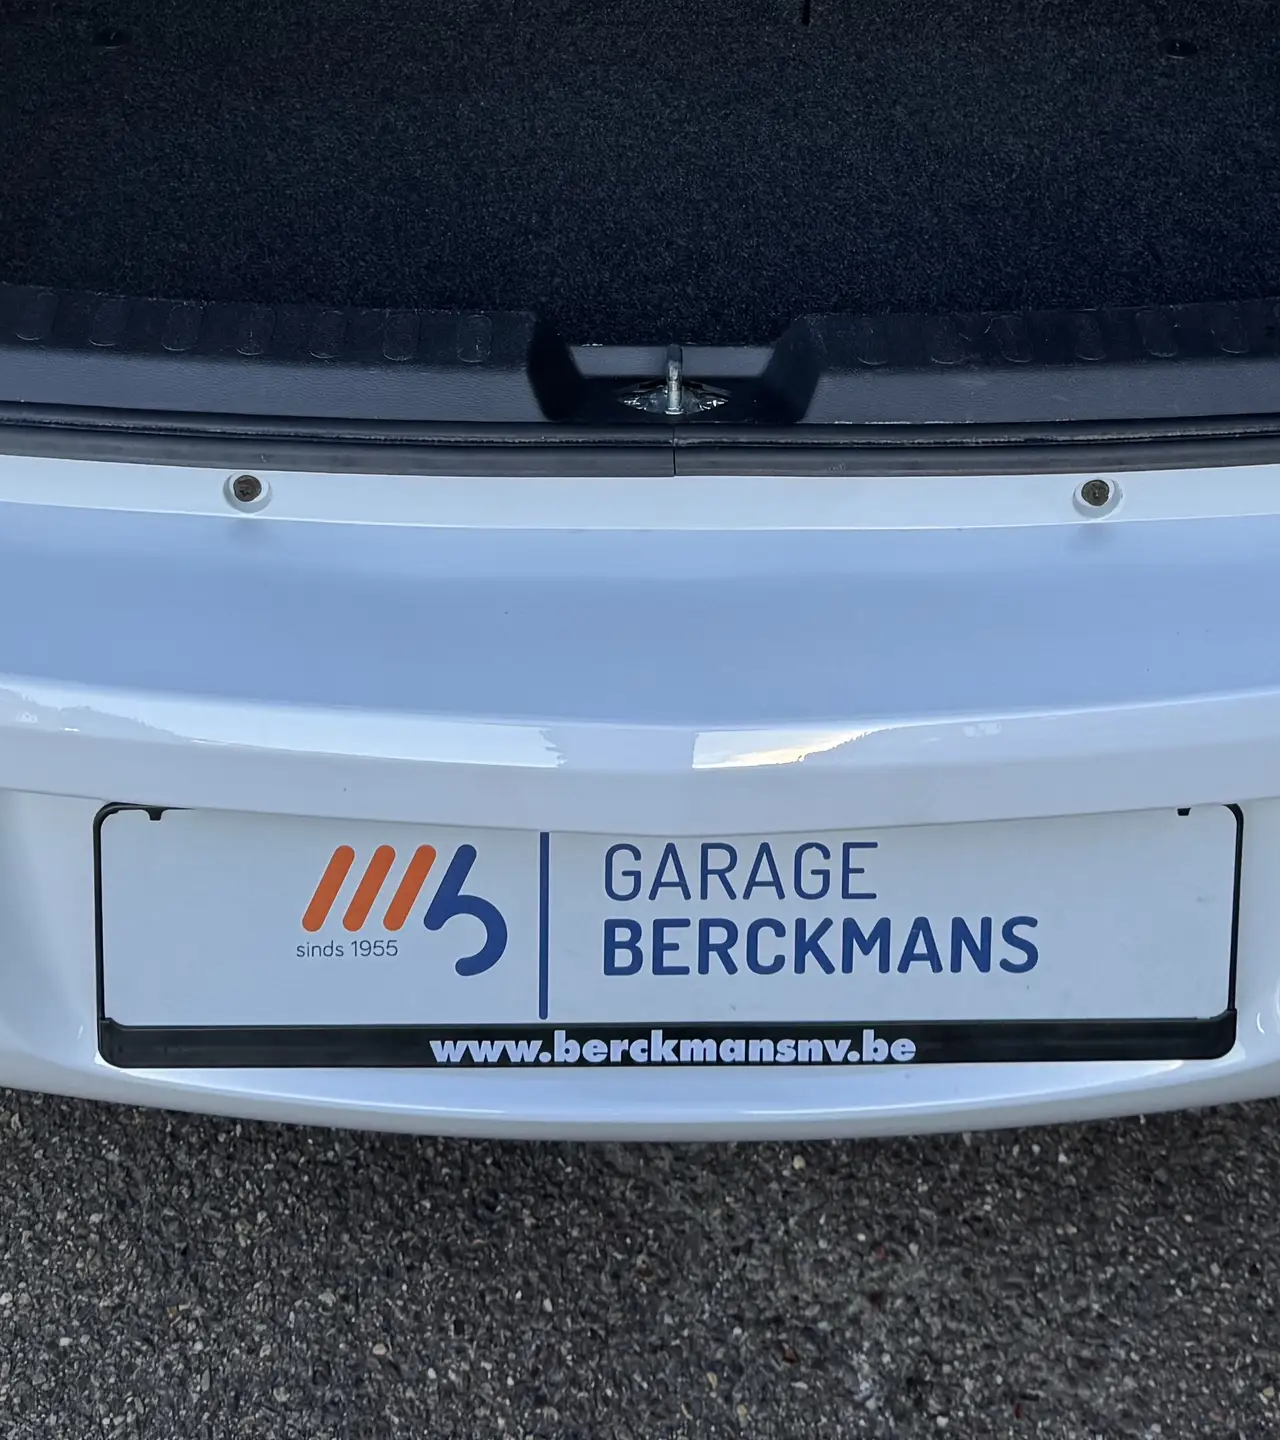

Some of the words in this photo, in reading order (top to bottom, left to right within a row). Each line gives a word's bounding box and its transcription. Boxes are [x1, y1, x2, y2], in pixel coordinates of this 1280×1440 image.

[603, 841, 879, 901] GARAGE
[296, 940, 345, 958] sinds
[350, 939, 399, 957] 1955
[603, 916, 1039, 976] BERCKMANS
[429, 1029, 917, 1063] www.berckmansnv.be
